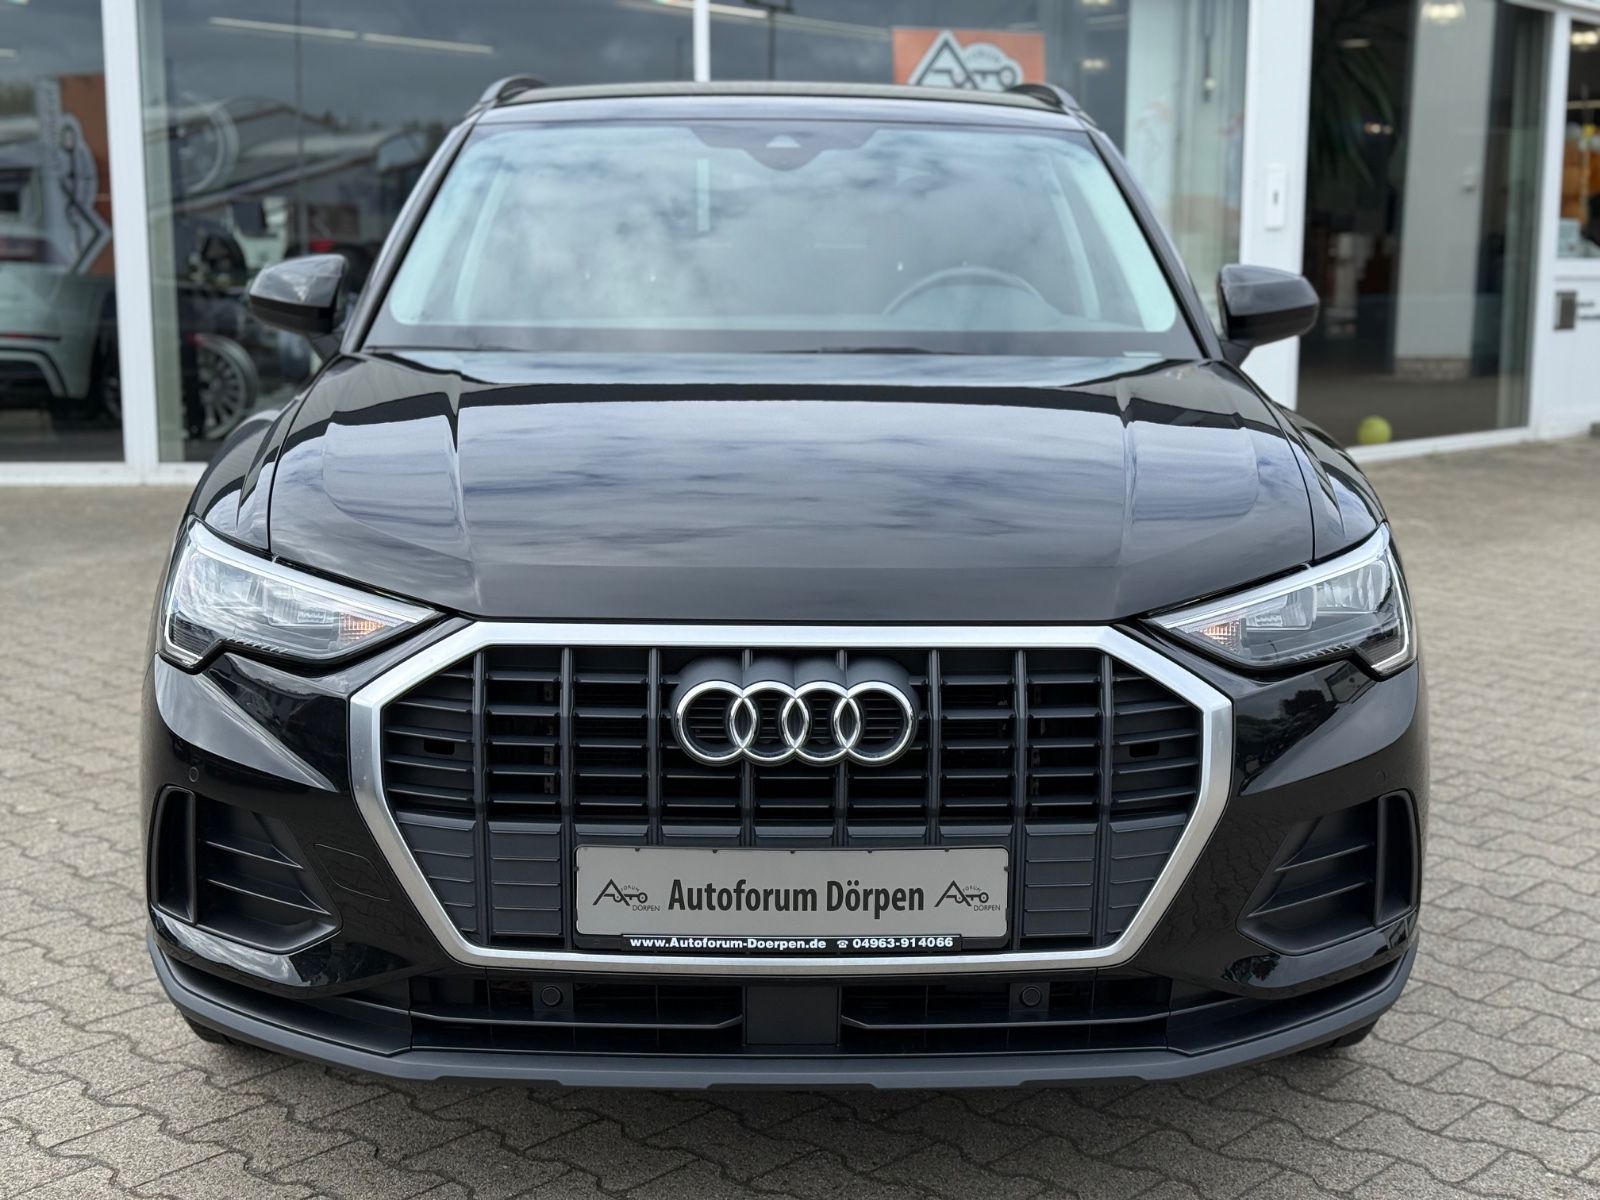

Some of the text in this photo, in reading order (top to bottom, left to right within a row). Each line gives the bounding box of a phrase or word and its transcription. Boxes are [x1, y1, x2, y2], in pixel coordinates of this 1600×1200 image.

[667, 878, 924, 920] Autoforum Dörpen
[629, 937, 954, 951] www.Autoforum-Doerpen.de 04963-914066
